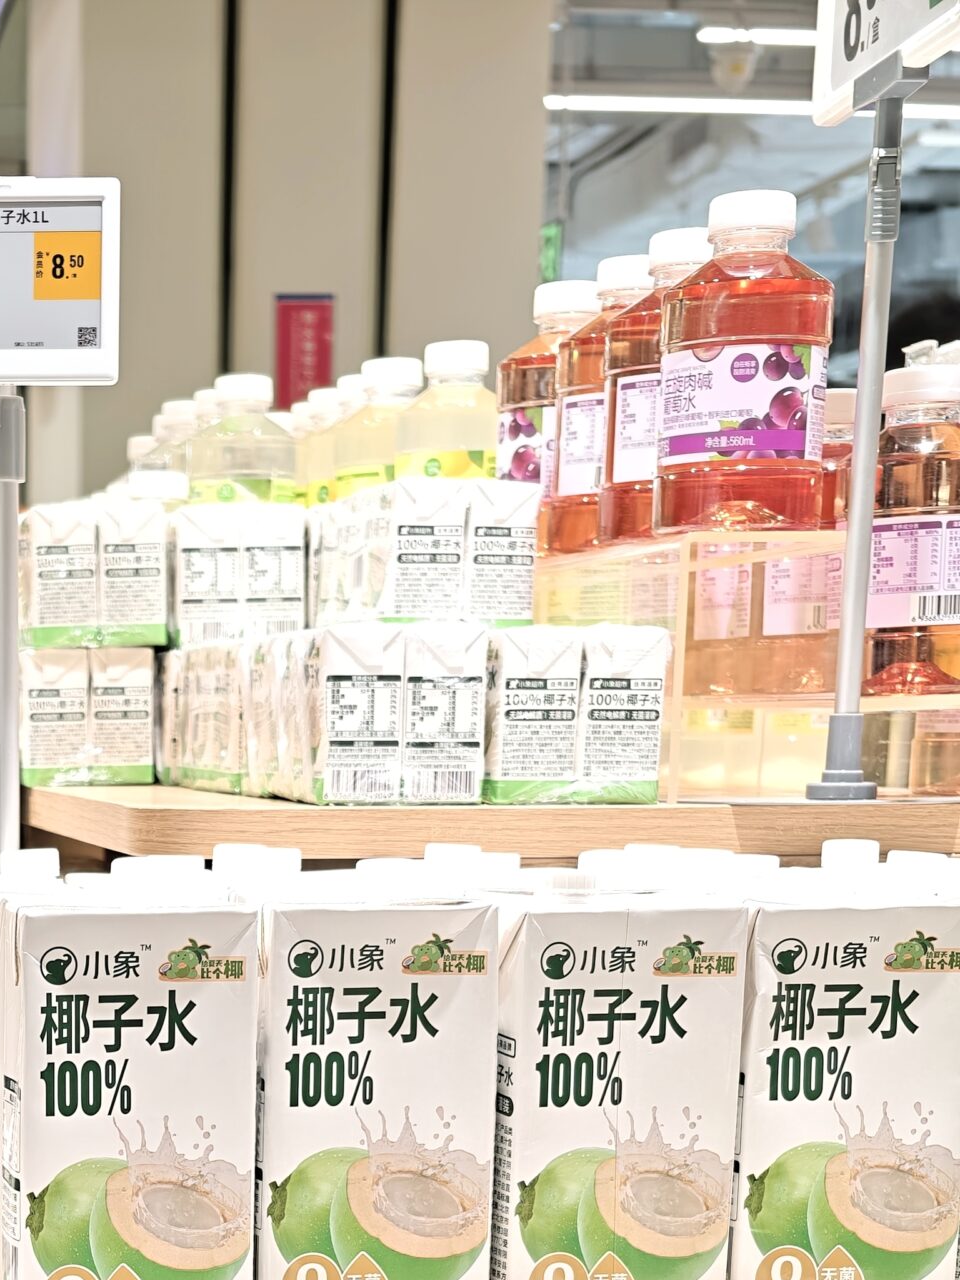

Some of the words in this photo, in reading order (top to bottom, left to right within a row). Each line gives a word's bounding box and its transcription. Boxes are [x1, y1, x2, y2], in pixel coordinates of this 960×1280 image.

[588, 693, 625, 706] 100%
[626, 693, 661, 707] 椰子水
[83, 950, 140, 979] 小象
[329, 944, 384, 971] 小象
[580, 946, 636, 974] 小象
[811, 942, 867, 969] 小象
[40, 990, 197, 1055] 椰子水
[286, 982, 439, 1046] 椰子水
[537, 984, 687, 1047] 椰子水
[769, 980, 919, 1041] 椰子水
[40, 1058, 132, 1117] 100%
[285, 1050, 373, 1107] 100%
[536, 1051, 623, 1108] 100%
[766, 1046, 852, 1101] 100%
